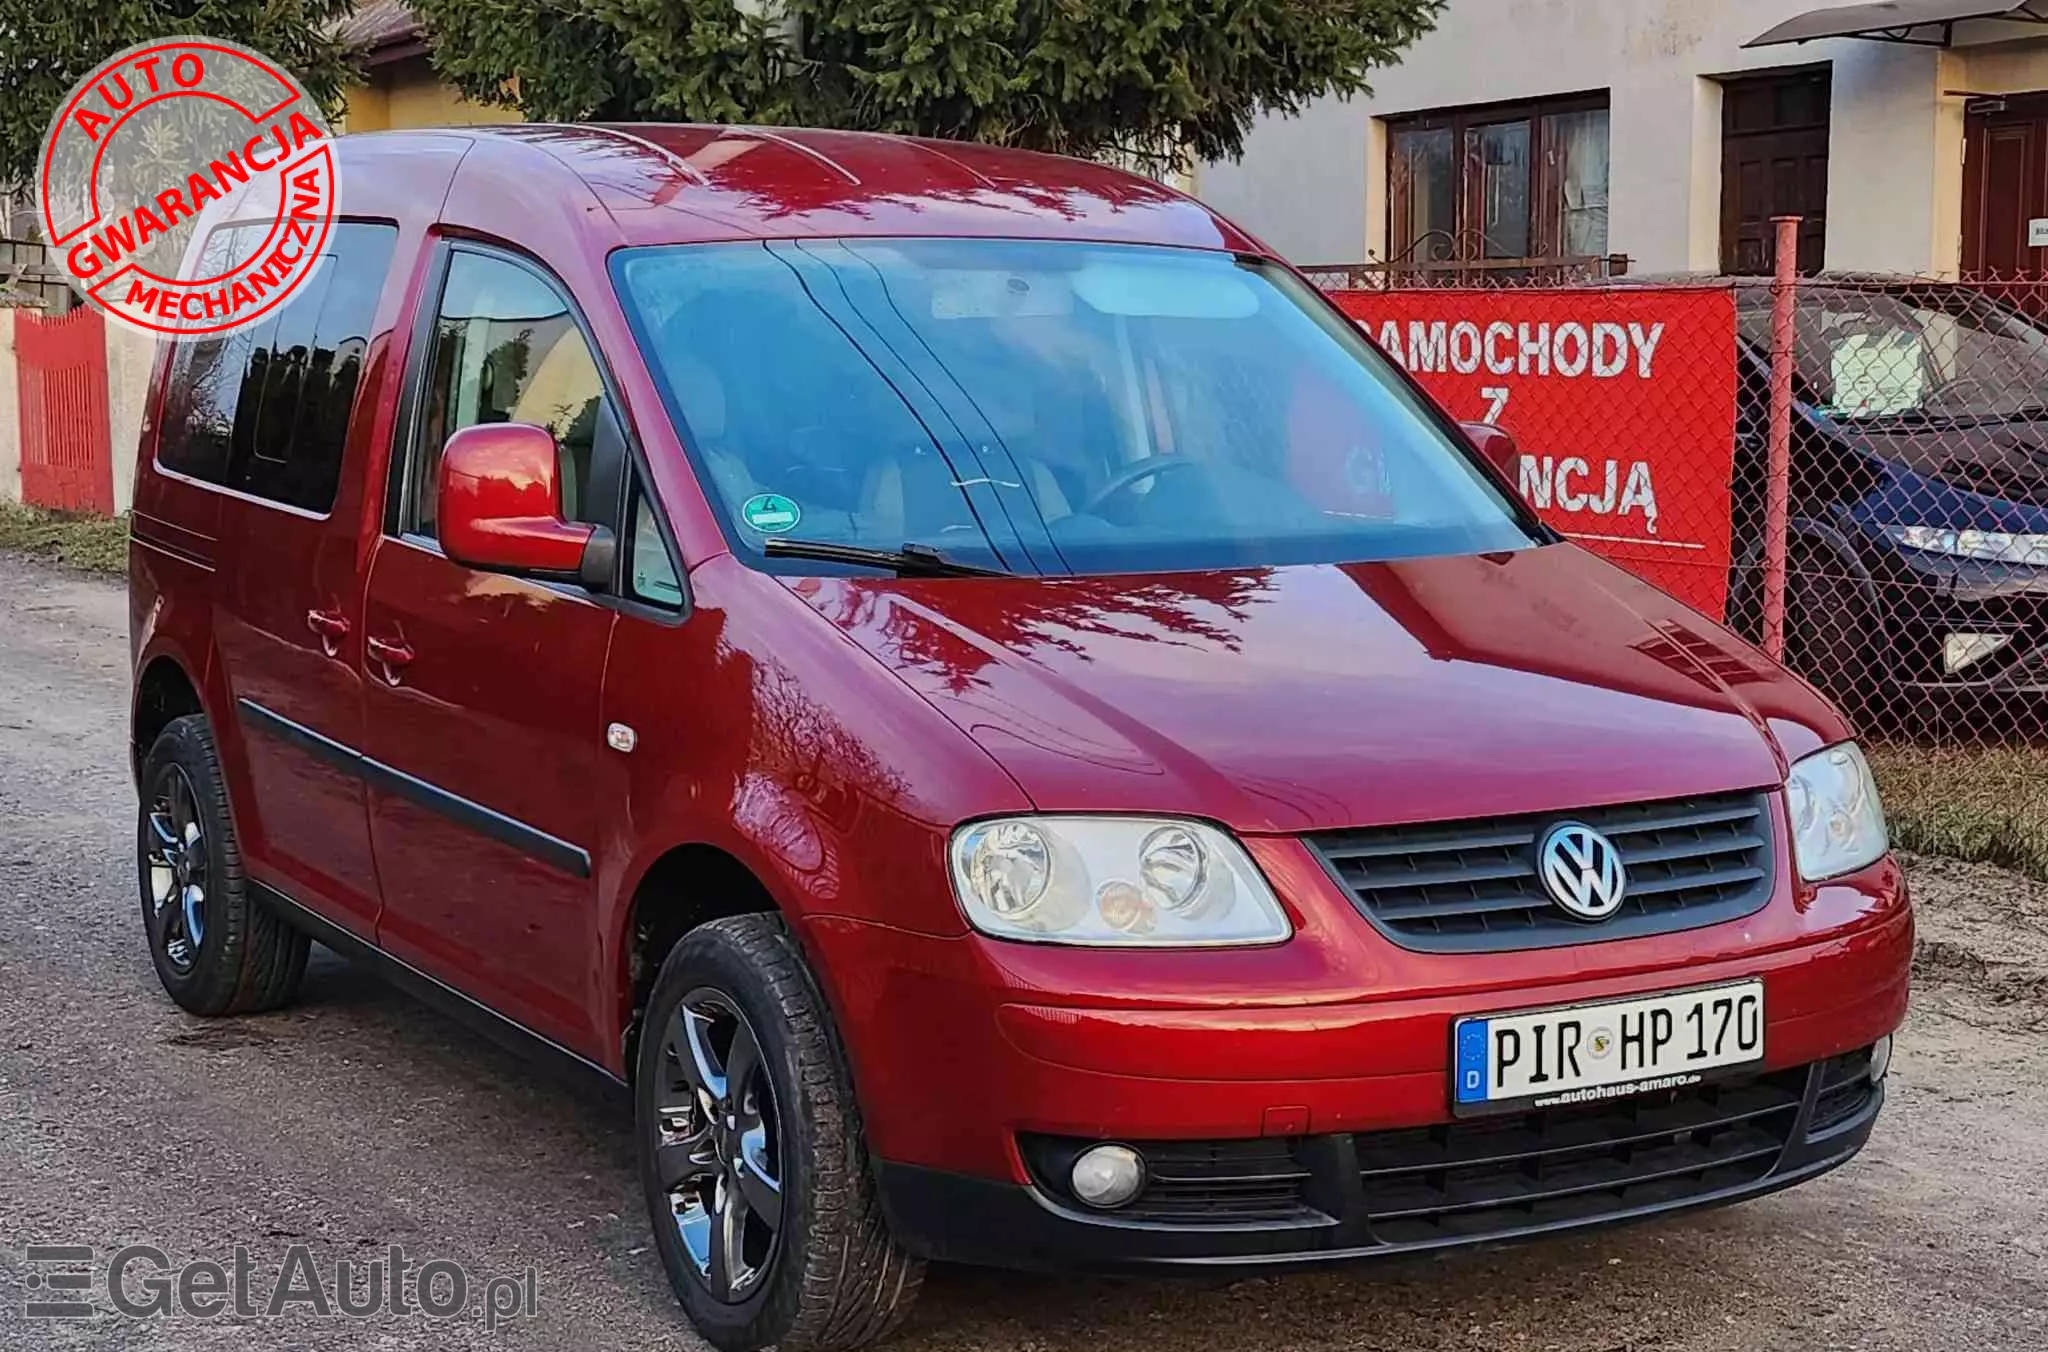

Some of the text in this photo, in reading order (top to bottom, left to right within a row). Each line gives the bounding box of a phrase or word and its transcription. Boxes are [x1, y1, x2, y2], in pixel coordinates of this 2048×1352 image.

[1354, 319, 1665, 379] AMOCHODY
[1519, 454, 1657, 534] NCJĄ
[1495, 994, 1758, 1089] PIR HP 170
[1466, 1070, 1480, 1090] D
[1534, 1074, 1702, 1107] www.autohaus-amaro.de
